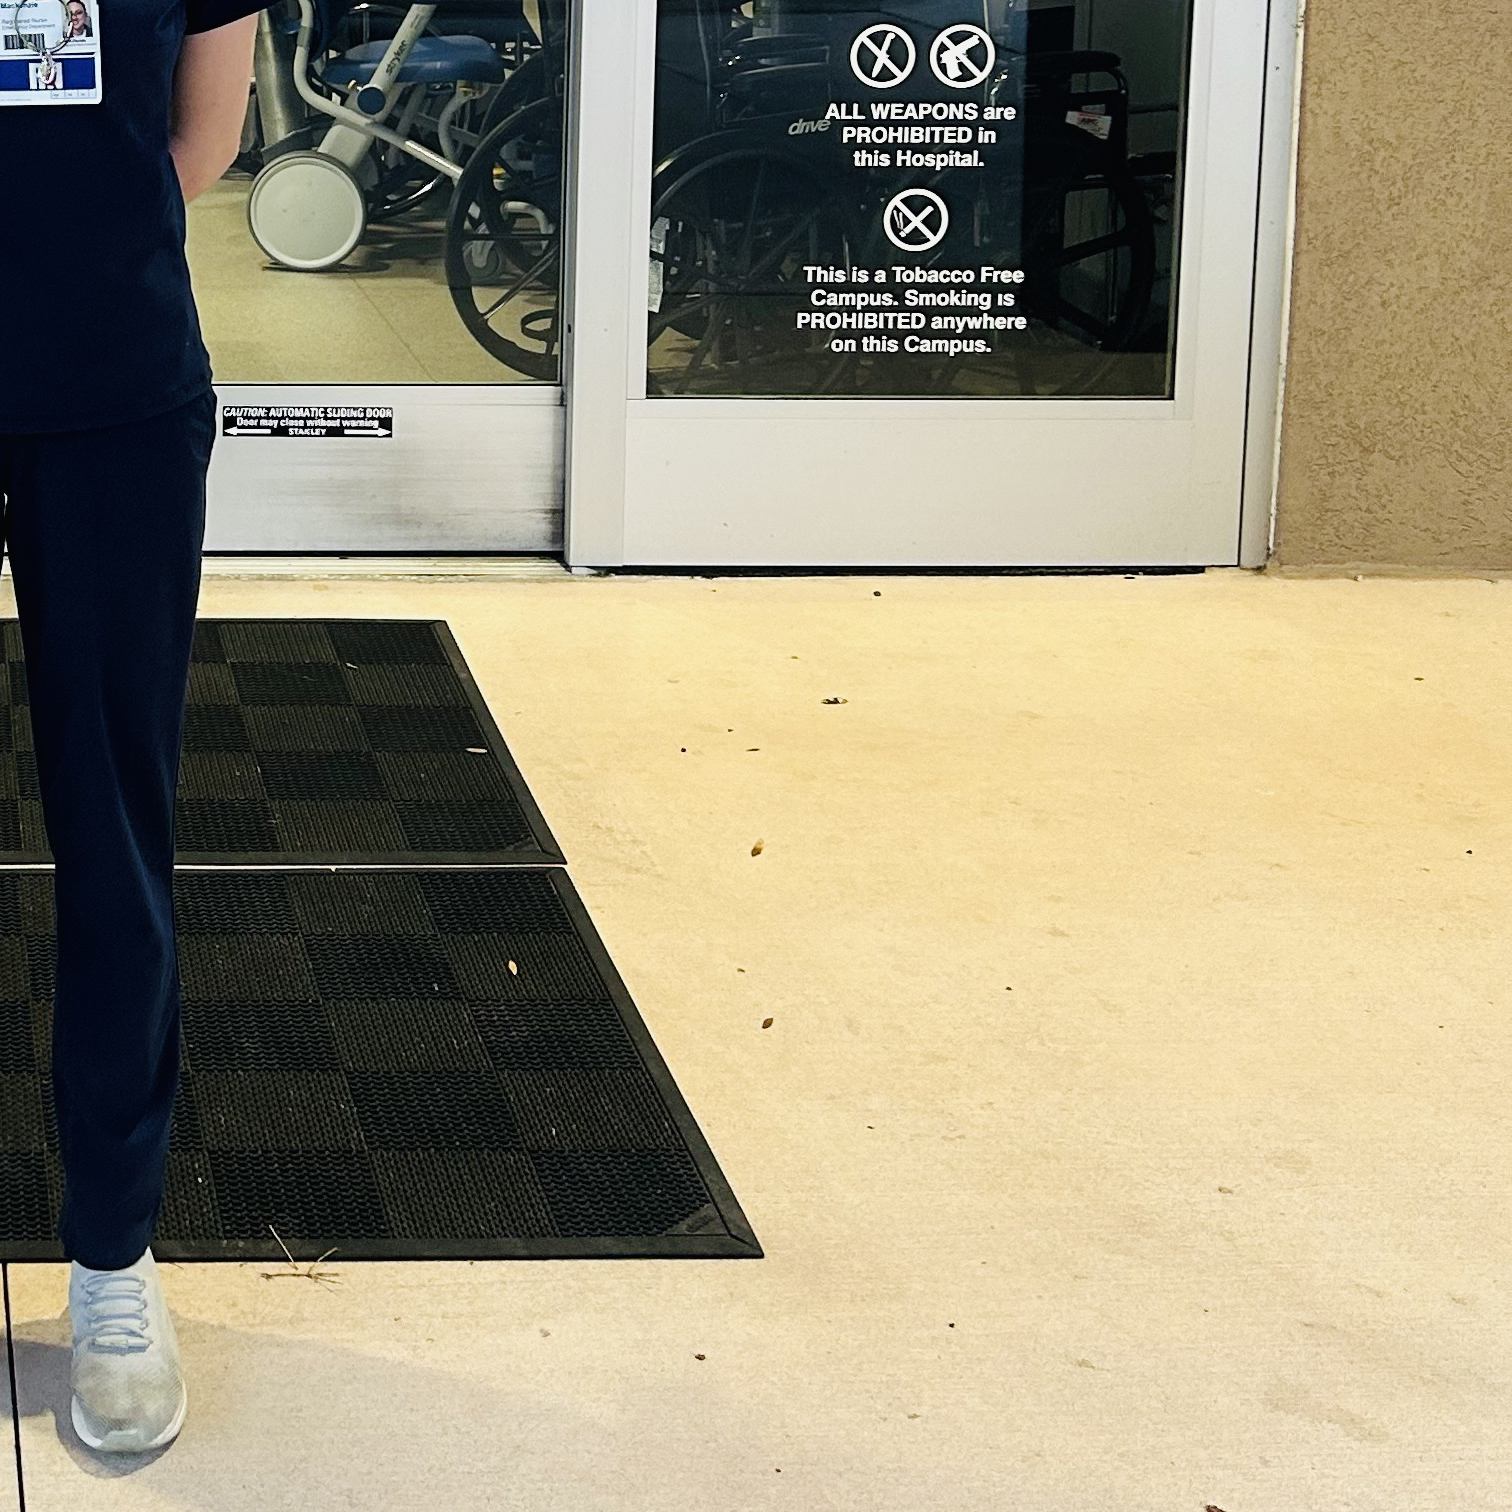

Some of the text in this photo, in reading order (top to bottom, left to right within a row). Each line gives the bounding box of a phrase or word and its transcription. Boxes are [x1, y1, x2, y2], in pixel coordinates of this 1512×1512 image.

[825, 103, 1016, 120] ALL WEAPONS are
[788, 118, 831, 135] drive
[842, 127, 996, 144] PROHIBITED in
[853, 150, 984, 170] this Hospital.
[803, 266, 1025, 283] This is a Tobacco Free
[811, 289, 1015, 310] Campus. Smoking is
[797, 313, 1027, 333] PROHIBITED anywhere
[830, 336, 992, 356] on this Campus.
[224, 407, 392, 418] CAUTION: AUTOMATIC SLIDING DOOR
[237, 418, 258, 426] Door
[260, 419, 278, 428] may
[306, 418, 340, 427] without
[342, 418, 378, 428] warning
[288, 428, 326, 436] STANLEY
